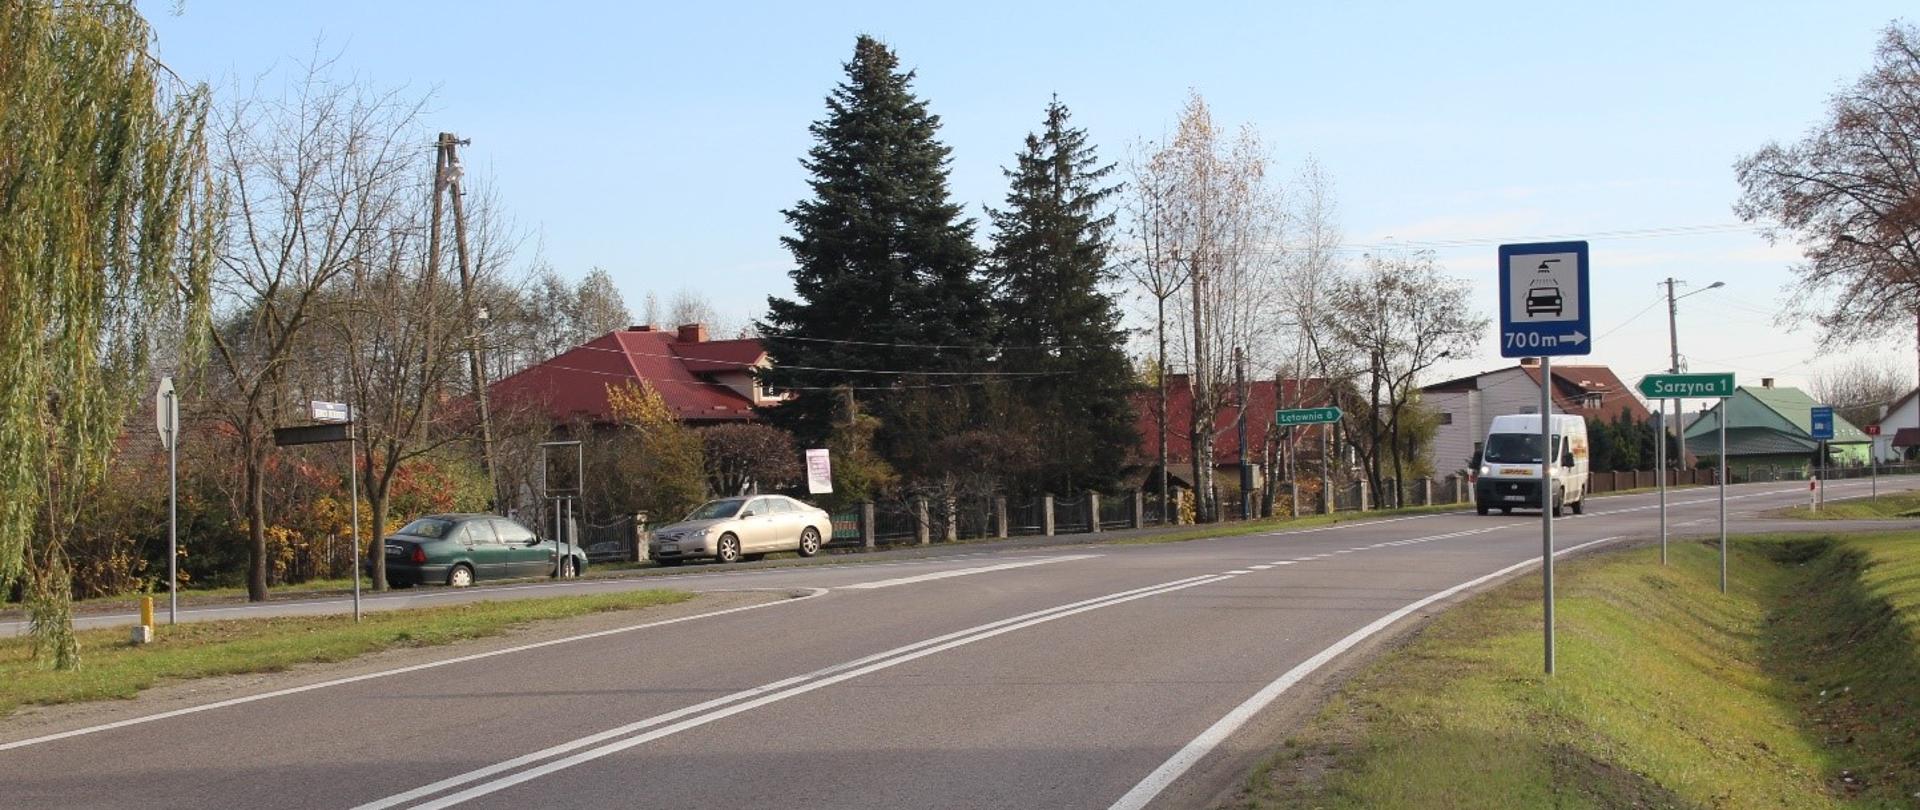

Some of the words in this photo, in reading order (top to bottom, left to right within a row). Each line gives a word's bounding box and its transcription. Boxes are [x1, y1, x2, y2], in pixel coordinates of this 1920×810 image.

[1505, 332, 1557, 349] 700m
[1654, 380, 1714, 396] Sarzyna
[1720, 379, 1727, 392] 1
